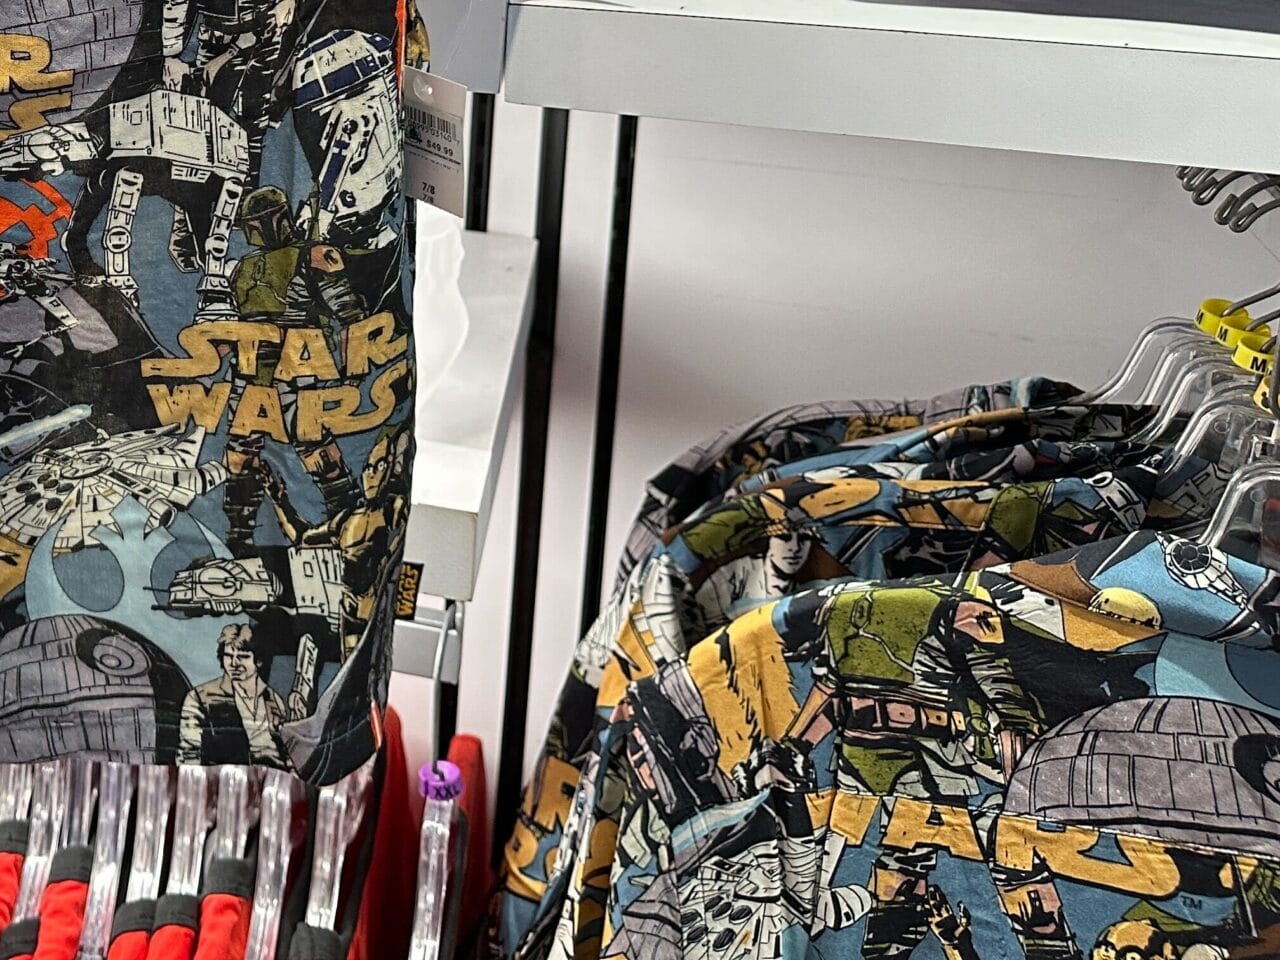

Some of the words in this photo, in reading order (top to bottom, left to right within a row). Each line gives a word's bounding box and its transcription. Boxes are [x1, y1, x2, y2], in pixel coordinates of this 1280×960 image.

[422, 182, 436, 195] 7/8
[1217, 325, 1229, 342] M
[140, 310, 408, 381] STAR
[1250, 355, 1268, 373] M
[145, 359, 408, 443] WARS
[396, 565, 419, 616] WARS
[1181, 895, 1202, 910] TM
